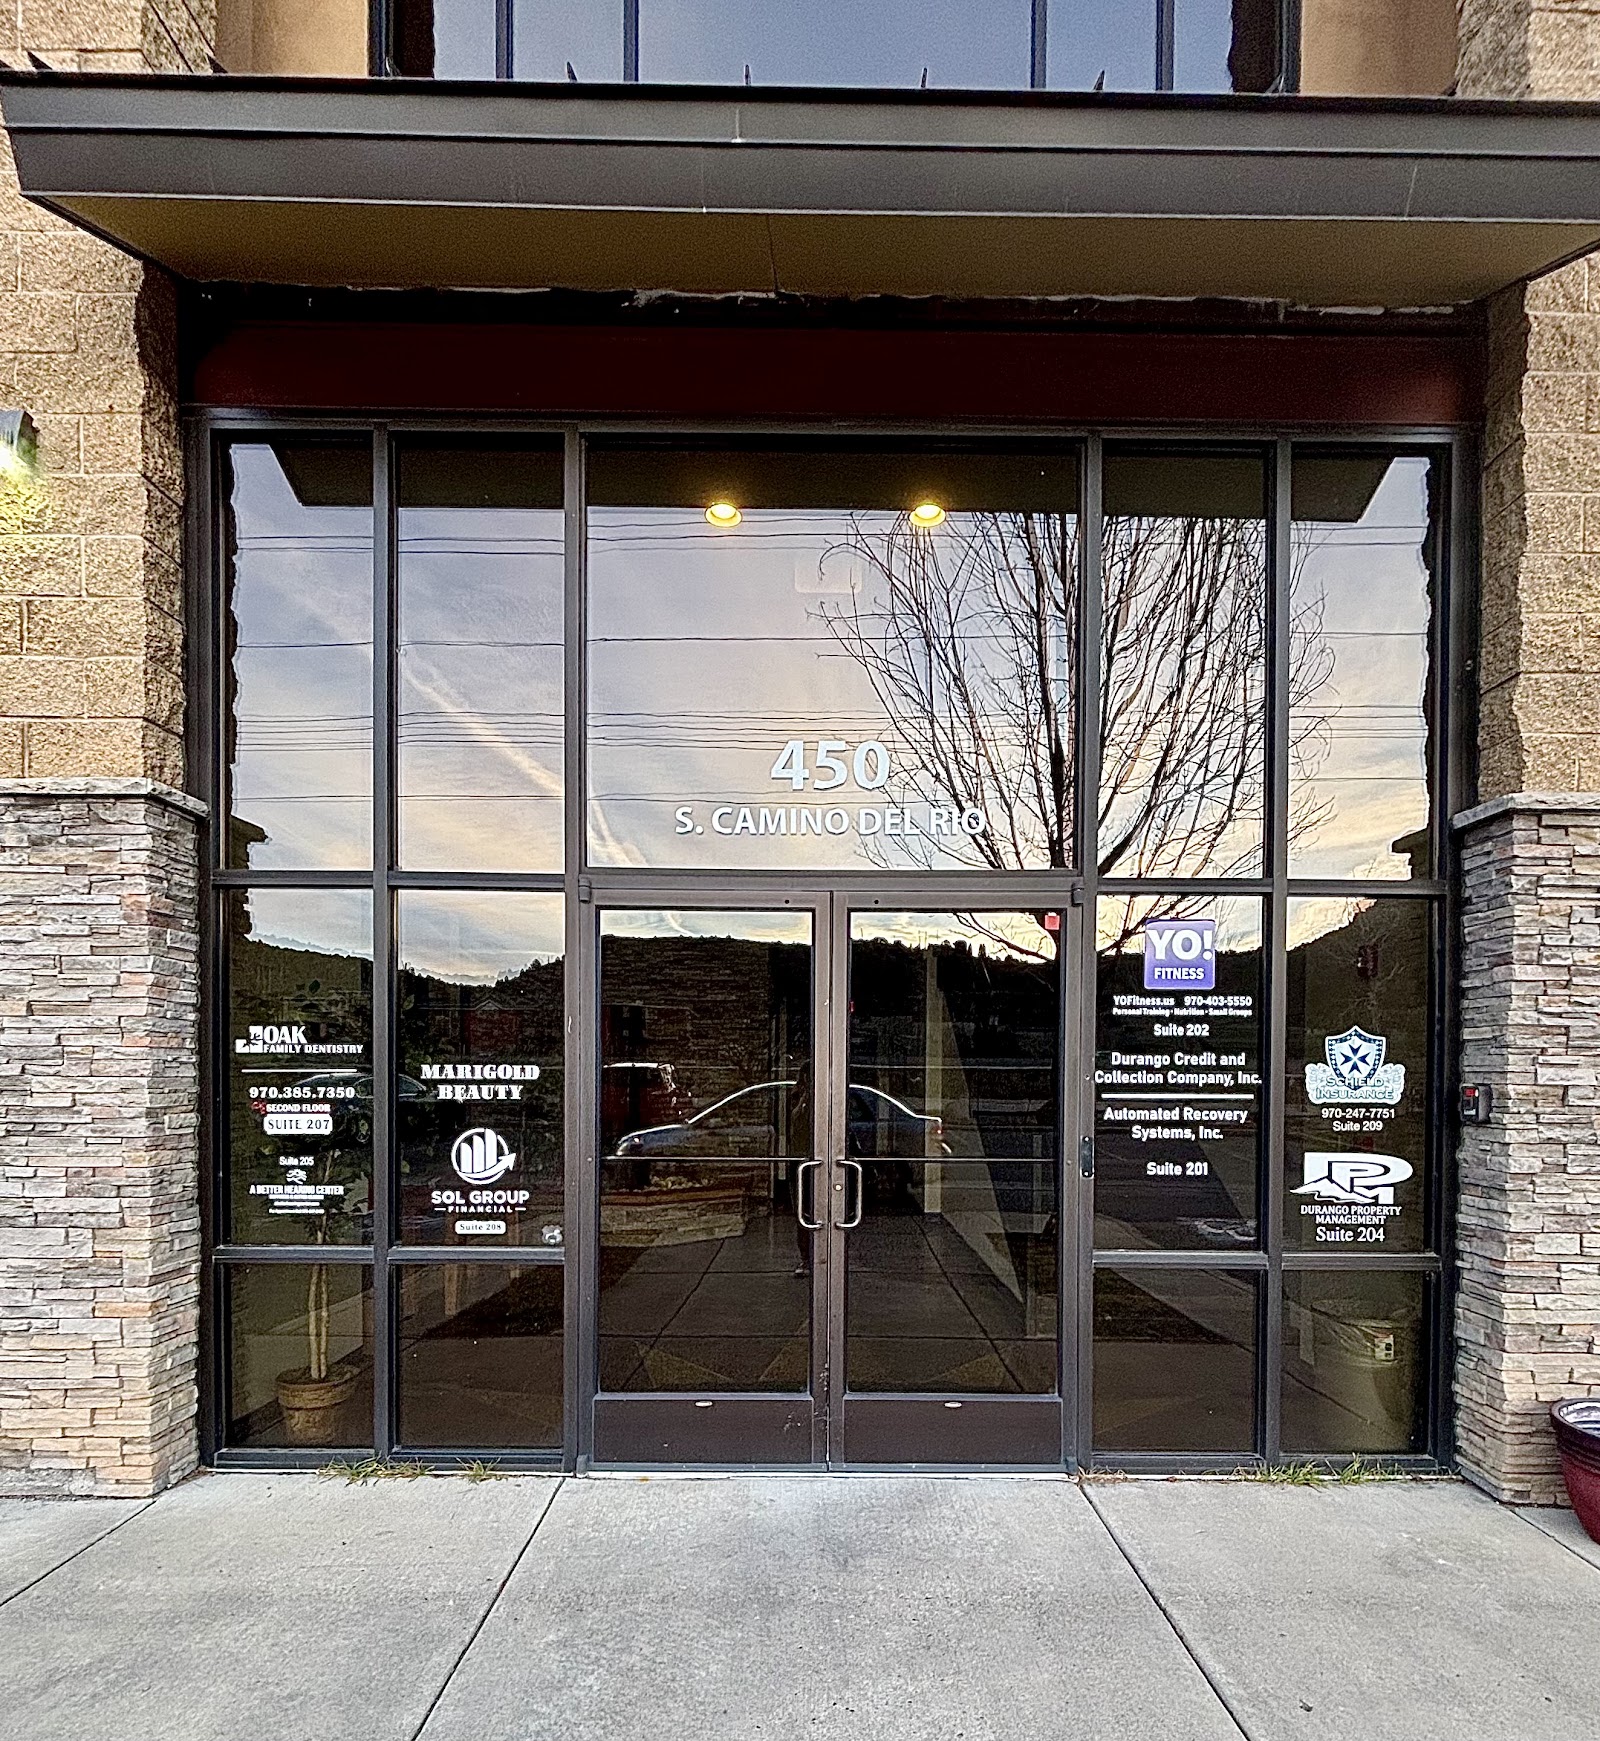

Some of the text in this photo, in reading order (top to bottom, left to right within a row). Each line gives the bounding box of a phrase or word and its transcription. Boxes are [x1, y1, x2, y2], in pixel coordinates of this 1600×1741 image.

[771, 740, 890, 791] 450
[675, 806, 986, 836] S. CAMINO DEL RIO
[1147, 930, 1213, 961] YO!
[1154, 968, 1204, 980] FITNESS
[1113, 995, 1252, 1006] YOFitness.us 970-403-5550
[1112, 1008, 1252, 1017] Personal Training Nutrition Small Groups
[263, 1026, 308, 1044] OAK
[1153, 1024, 1210, 1036] Suite 202
[263, 1045, 363, 1054] FAMILY DENTISTRY
[1111, 1053, 1246, 1068] Durango Credit and
[420, 1064, 540, 1080] MARIGOLD
[1094, 1070, 1262, 1087] Collection Company, Inc.
[1326, 1077, 1384, 1087] SCHIELD
[249, 1087, 355, 1099] 970.385.7350
[437, 1085, 524, 1100] BEAUTY
[1316, 1089, 1393, 1099] INSURANCE
[266, 1104, 331, 1113] SECOND FLOOR
[1321, 1108, 1395, 1119] 970-247-7751
[1104, 1107, 1248, 1123] Automated Recovery
[267, 1119, 330, 1130] SUITE 207
[1332, 1121, 1383, 1132] Suite 209
[1131, 1126, 1224, 1141] Systems, Inc.
[279, 1156, 315, 1166] Suite 205
[1146, 1162, 1208, 1175] Suite 201
[249, 1184, 256, 1195] A
[316, 1185, 344, 1195] CENTER
[431, 1190, 529, 1204] SOL GROUP
[1300, 1205, 1402, 1215] DURANGO PROPERTY
[1315, 1215, 1386, 1225] MANAGEMENT
[459, 1223, 484, 1231] Suite
[1316, 1227, 1385, 1242] Suite 204
